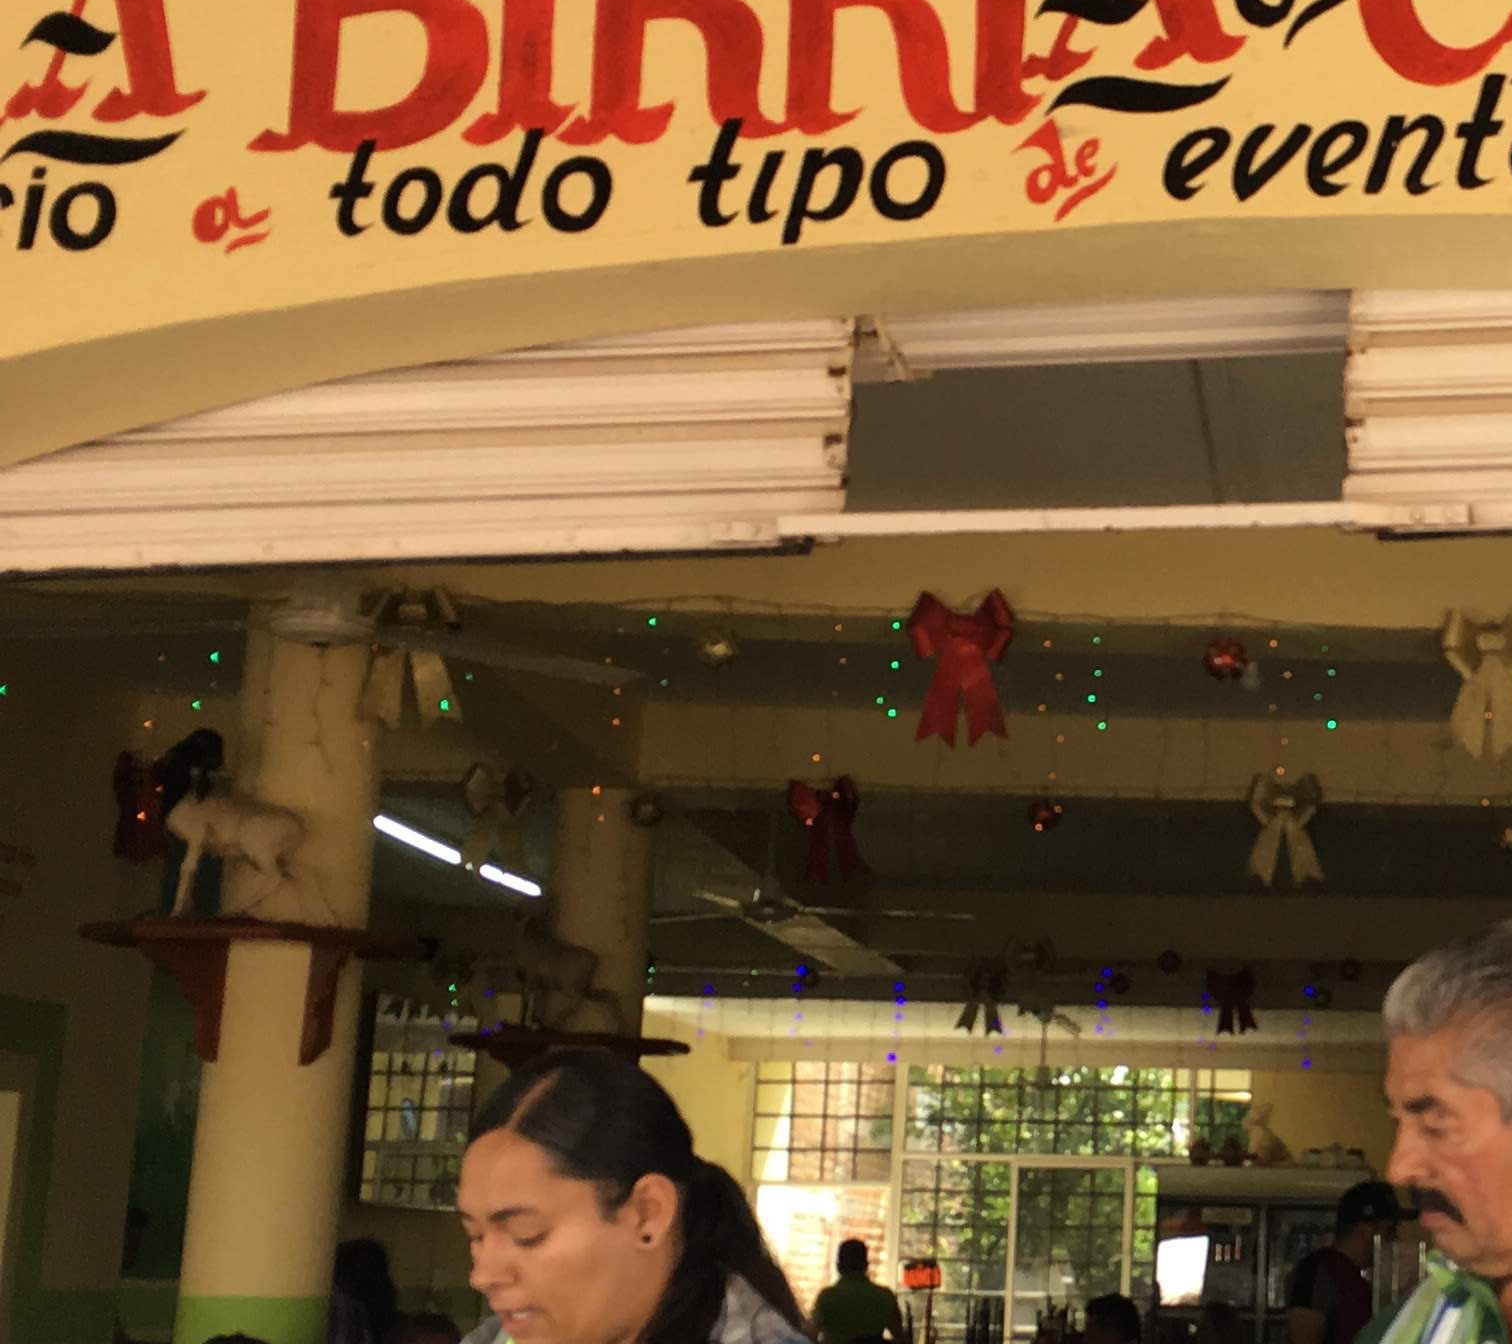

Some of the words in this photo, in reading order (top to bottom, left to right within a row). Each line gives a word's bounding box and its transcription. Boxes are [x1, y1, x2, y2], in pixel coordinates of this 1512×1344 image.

[192, 186, 272, 248] a
[329, 128, 614, 237] todo
[687, 118, 947, 245] tipo
[1012, 118, 1112, 210] de
